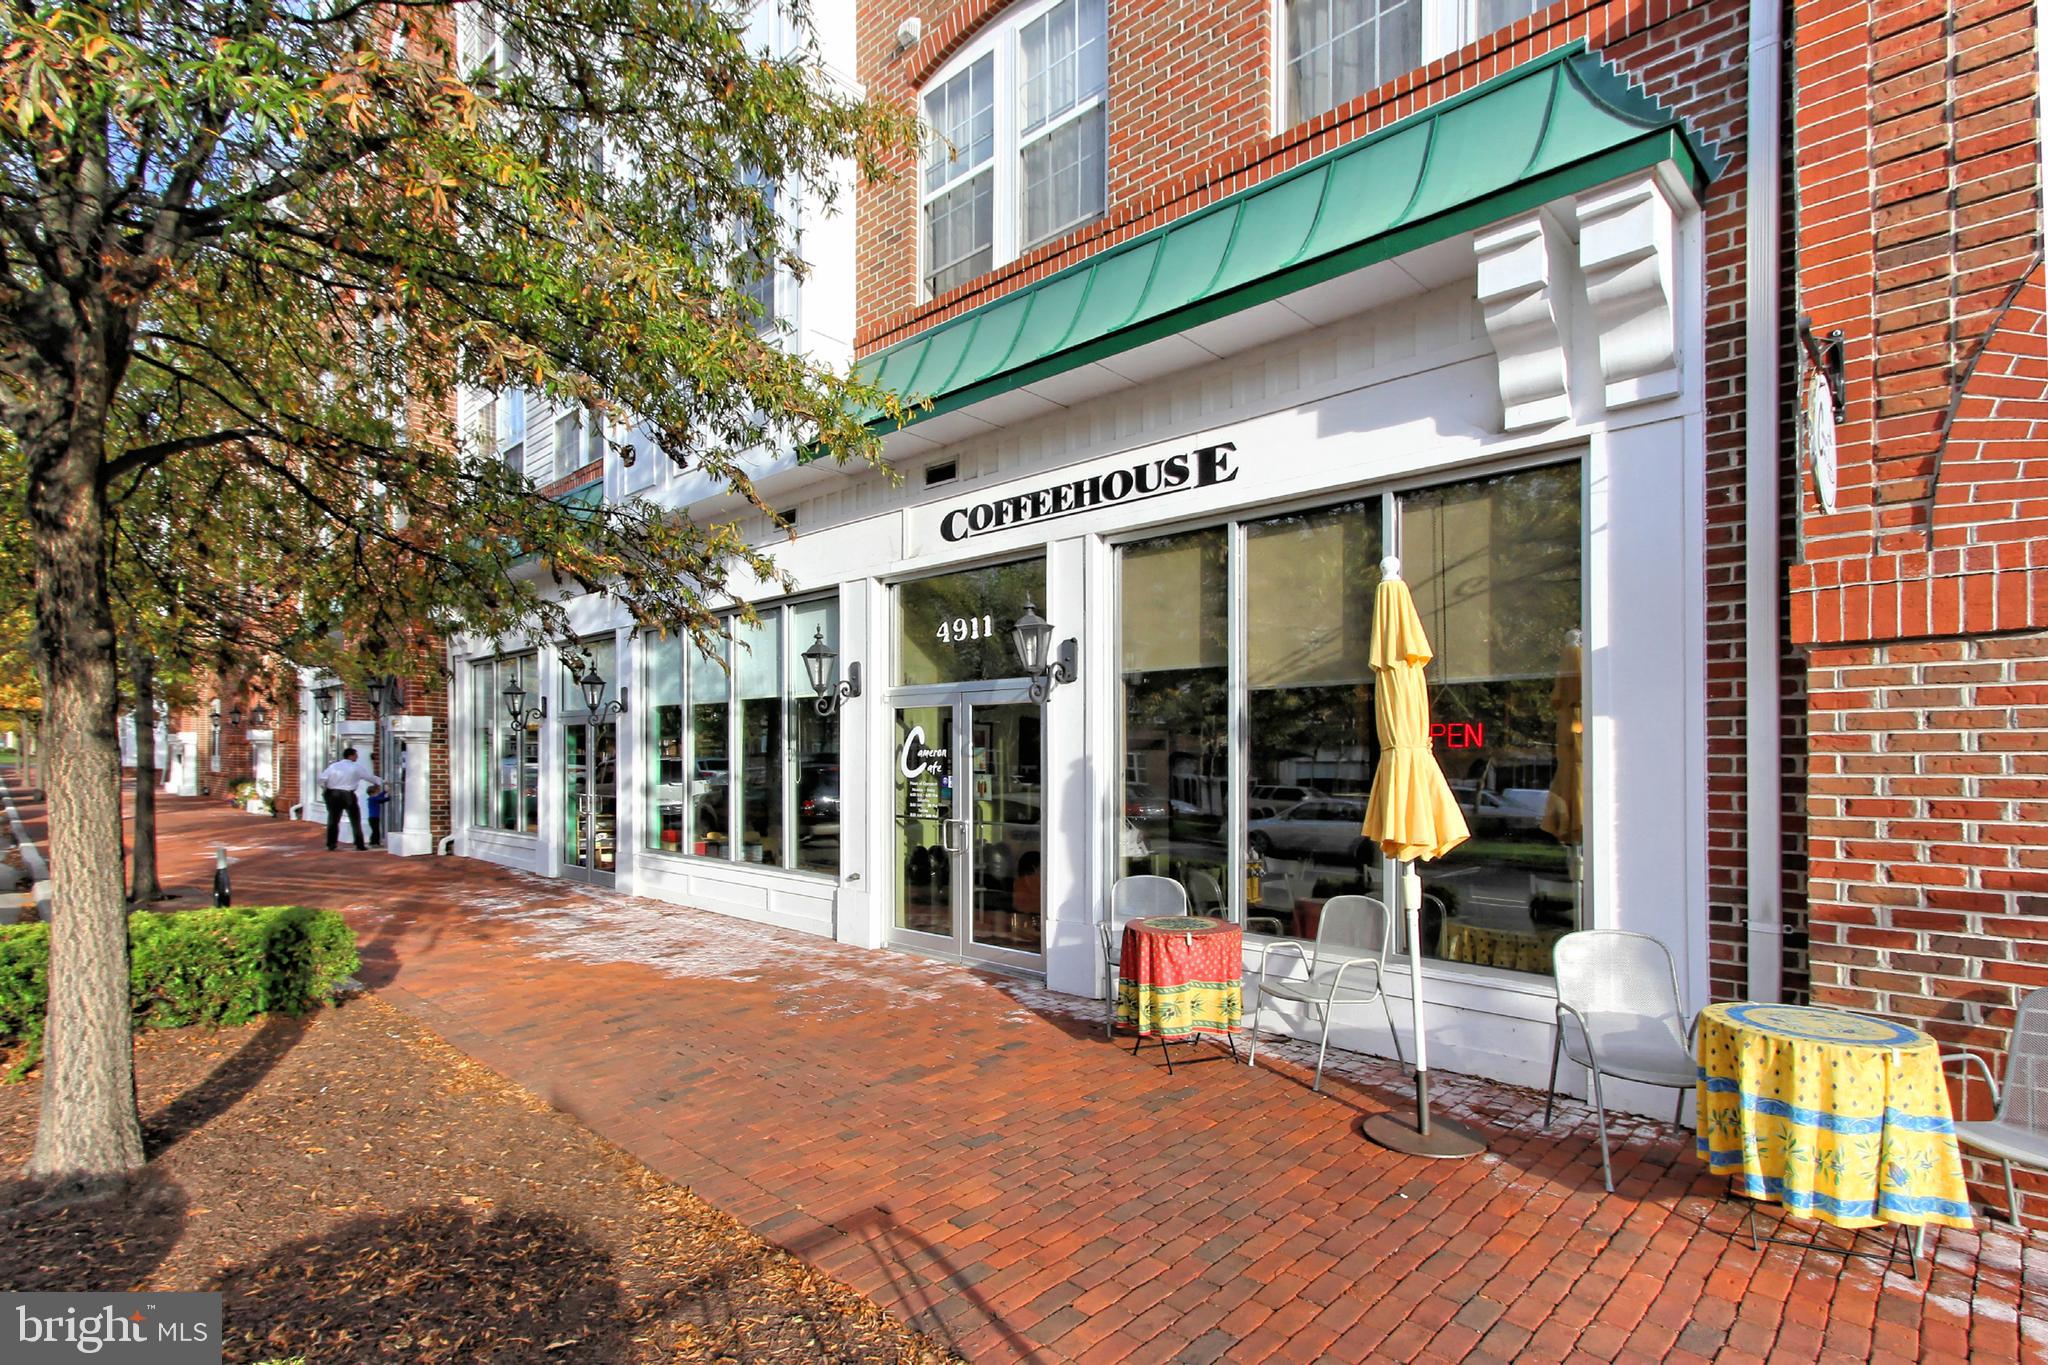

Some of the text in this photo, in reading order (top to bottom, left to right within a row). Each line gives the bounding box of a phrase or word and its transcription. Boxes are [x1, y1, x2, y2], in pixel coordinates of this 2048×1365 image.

[940, 442, 1239, 542] COFFEEHOUSE
[936, 615, 993, 643] 4911
[1430, 722, 1484, 748] PEN
